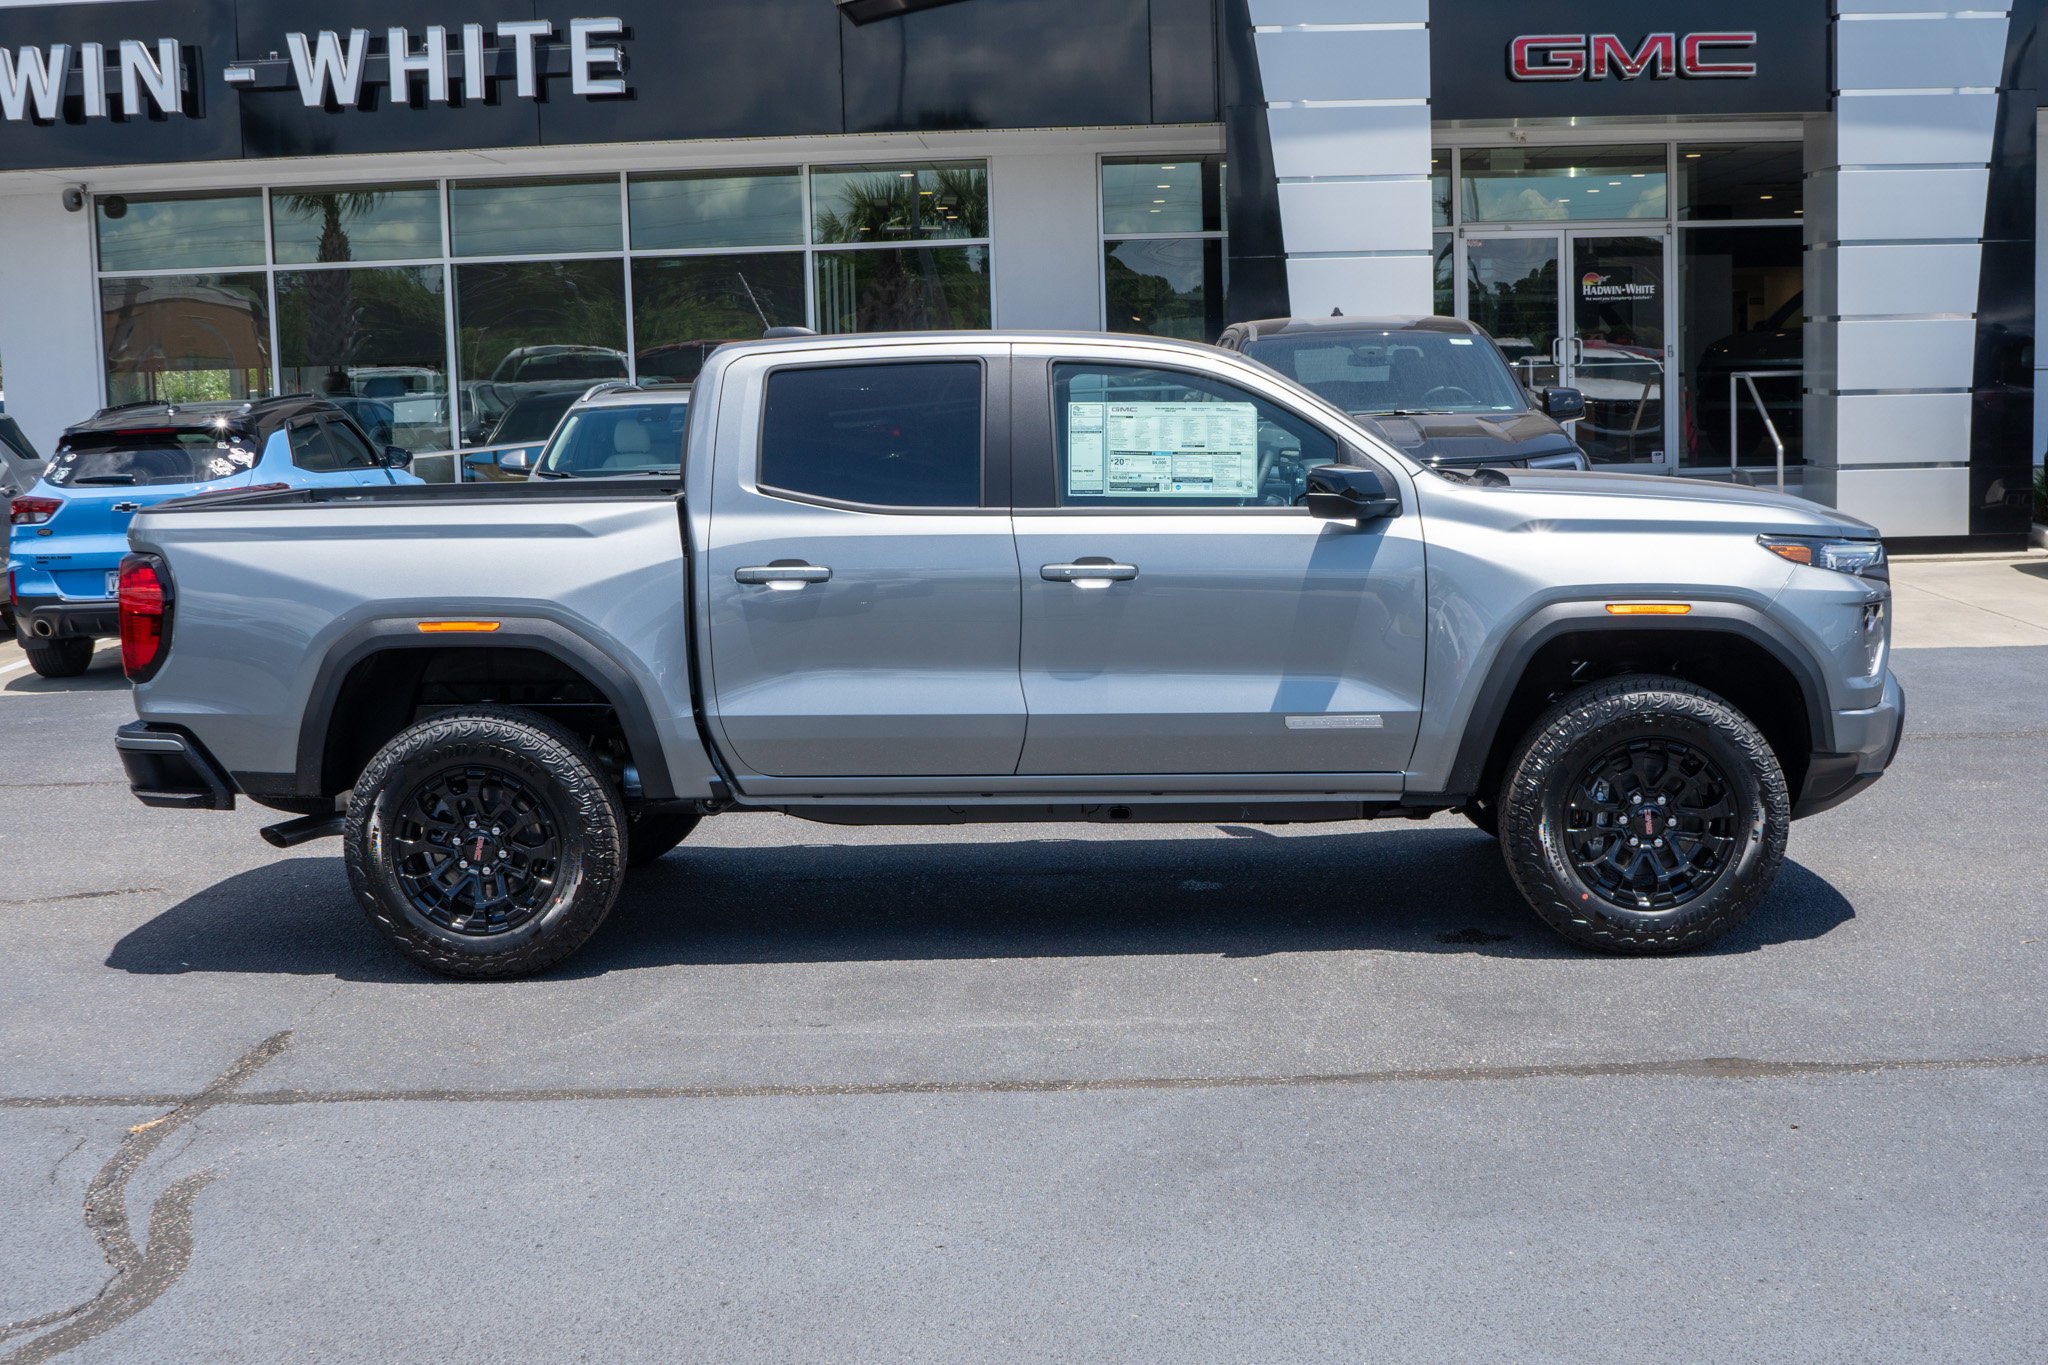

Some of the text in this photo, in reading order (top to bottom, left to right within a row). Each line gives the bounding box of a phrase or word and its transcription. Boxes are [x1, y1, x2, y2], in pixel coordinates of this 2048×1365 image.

[285, 17, 626, 107] WHITE
[1512, 32, 1757, 80] GMC
[1583, 284, 1655, 296] HADWIN-WHITE
[1114, 458, 1124, 466] 20
